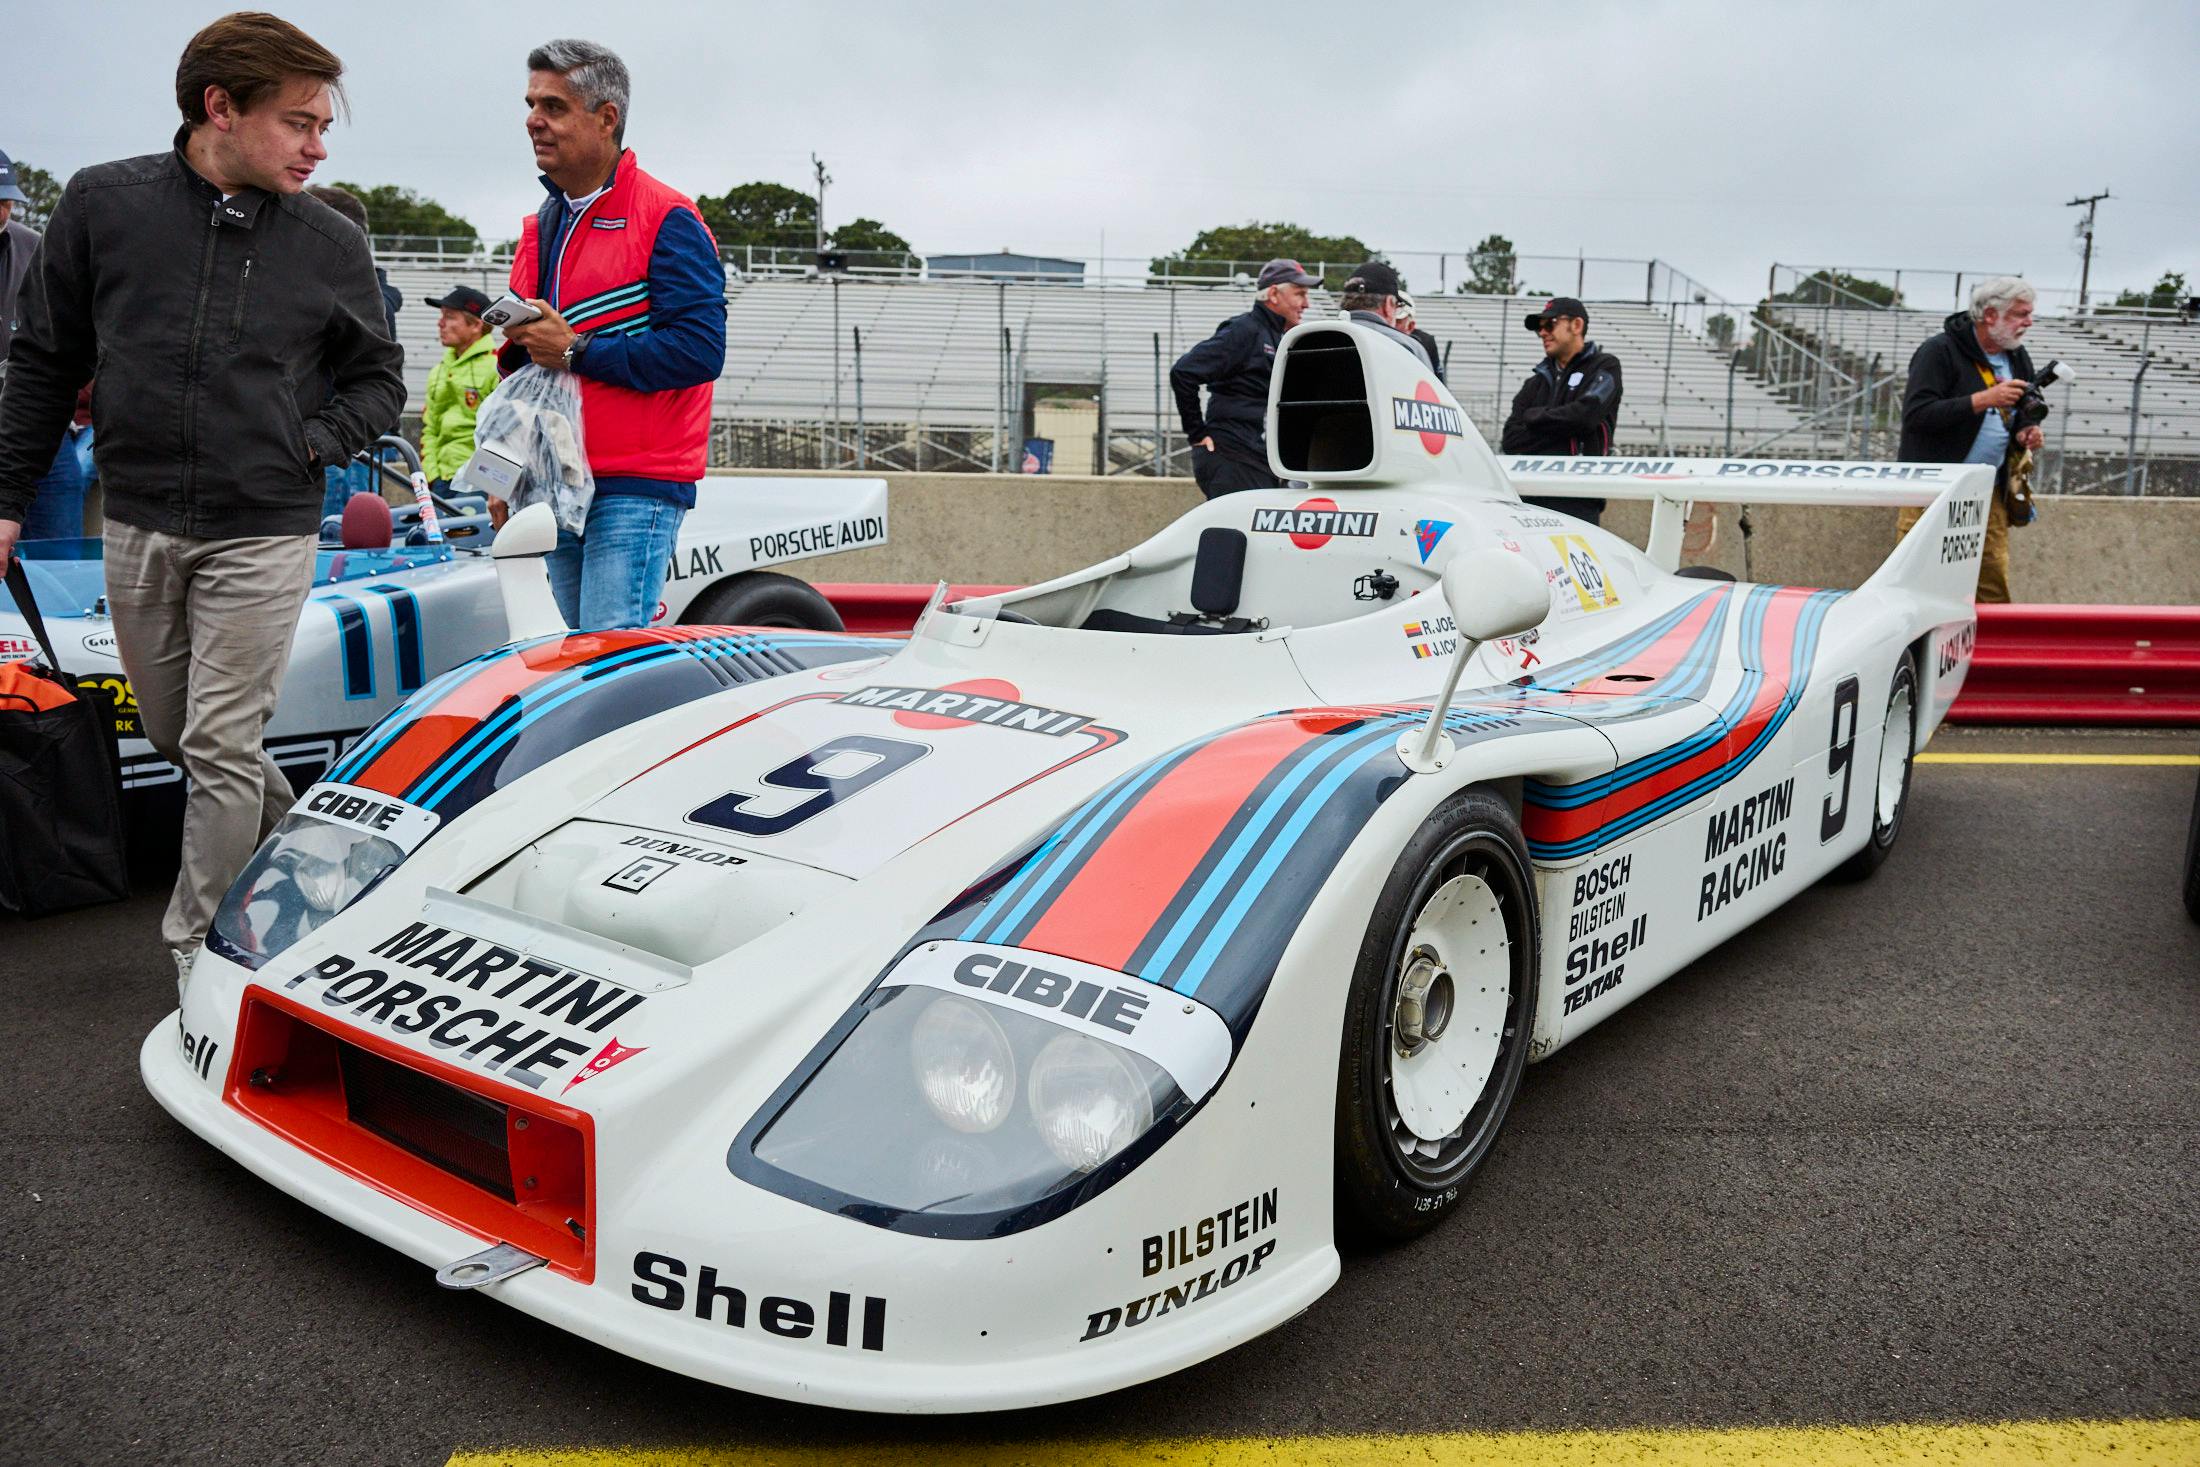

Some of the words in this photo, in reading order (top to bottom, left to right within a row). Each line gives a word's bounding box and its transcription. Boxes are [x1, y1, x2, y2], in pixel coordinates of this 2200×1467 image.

[1394, 399, 1461, 436] MARTINI
[1510, 459, 1675, 477] MARTINI
[1717, 463, 1943, 481] PORSCHE
[1255, 510, 1376, 537] MARTINI
[1948, 501, 1984, 529] MARTINI
[1941, 532, 1981, 565] PORSCHE
[844, 687, 1084, 735] MARTINI
[685, 734, 932, 838] 9
[1820, 673, 1859, 847] 9
[1704, 777, 1795, 863] MARTINI
[619, 835, 748, 867] DUNLOP
[1698, 832, 1787, 923] RACING
[1573, 853, 1633, 908] BOSCH
[1569, 891, 1626, 943] BILSTEIN
[1565, 912, 1648, 986] Shell
[368, 921, 648, 1034] MARTINI
[1563, 963, 1625, 1018] TEXTAR
[284, 954, 591, 1090] PORSCHE
[577, 1046, 627, 1080] TOW
[1142, 1186, 1279, 1279] BILSTEIN
[632, 1250, 887, 1352] Shell
[1080, 1237, 1277, 1343] DUNLOP
